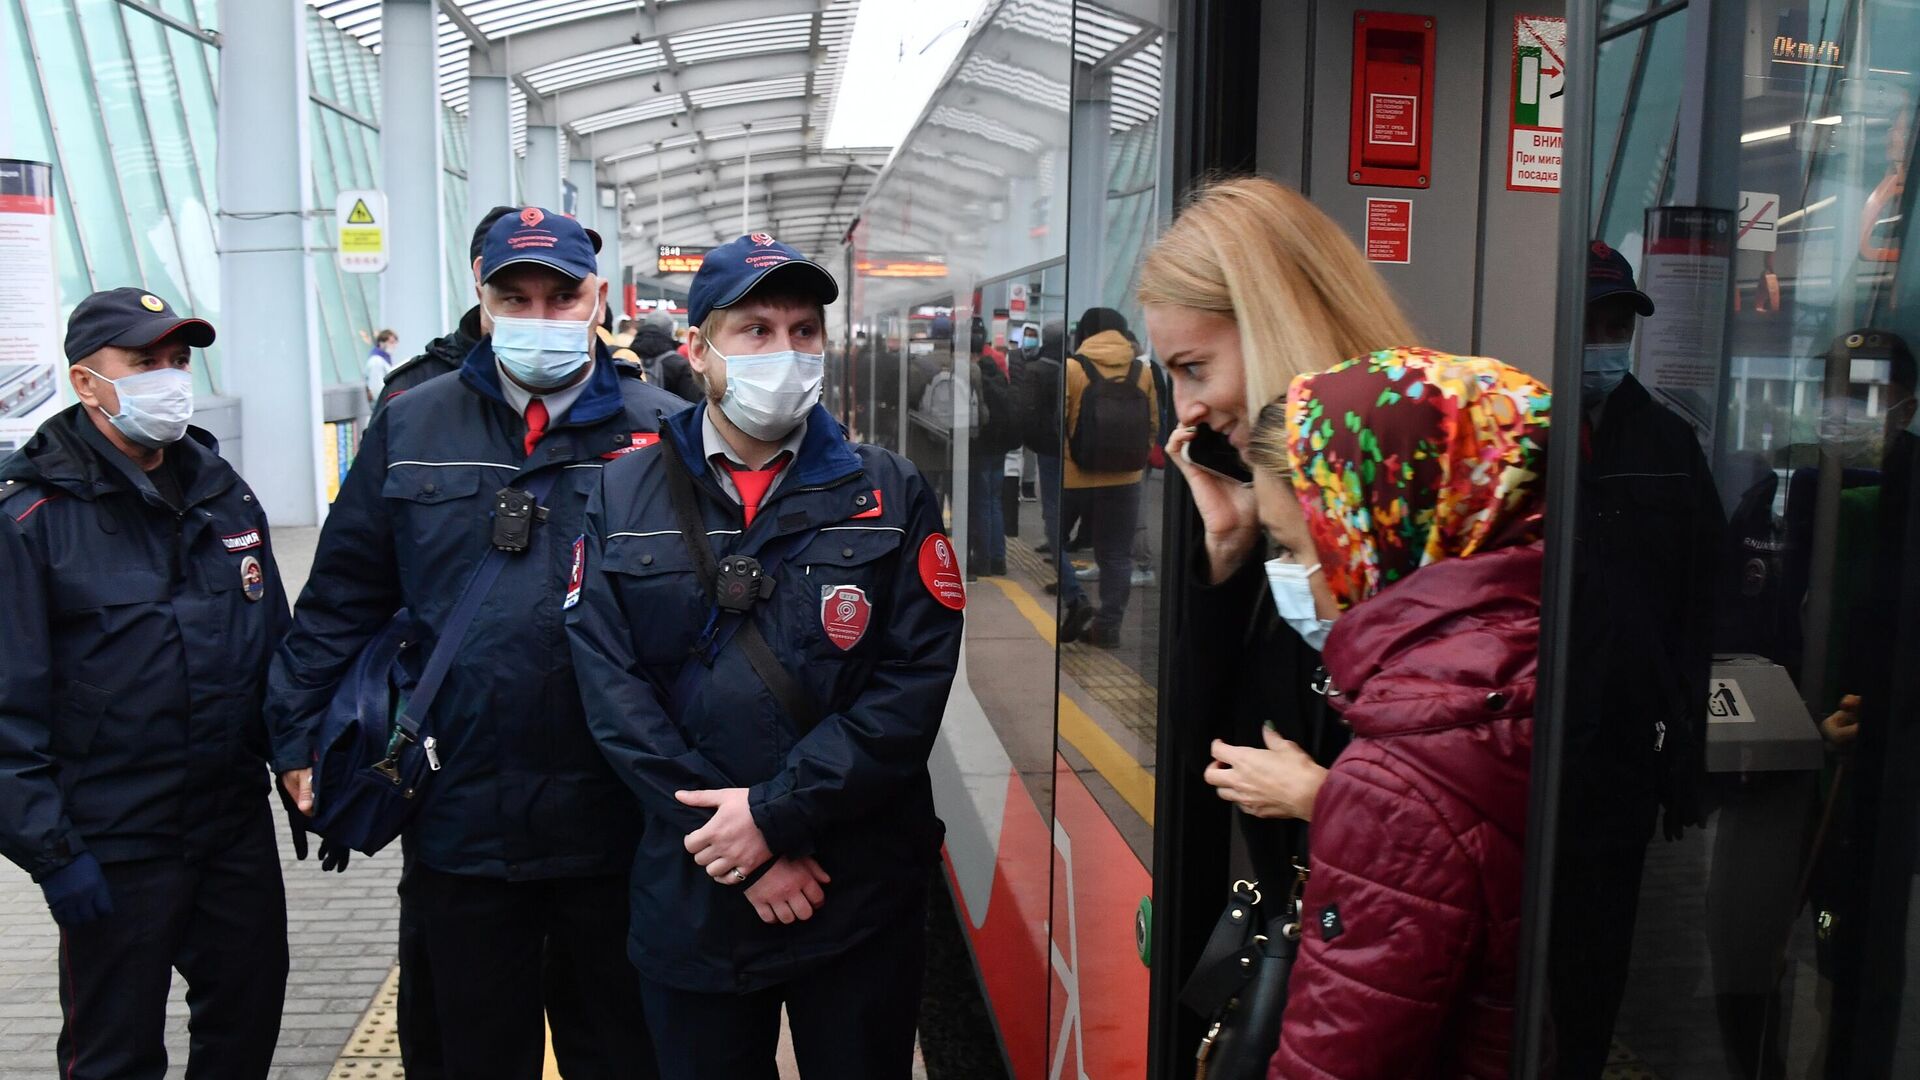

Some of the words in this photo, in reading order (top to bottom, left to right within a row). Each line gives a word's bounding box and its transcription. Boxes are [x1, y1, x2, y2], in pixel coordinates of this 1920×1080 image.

[1773, 36, 1840, 62] 0km/h
[1516, 150, 1536, 166] При
[1538, 155, 1562, 166] мига
[1518, 169, 1558, 182] посадка
